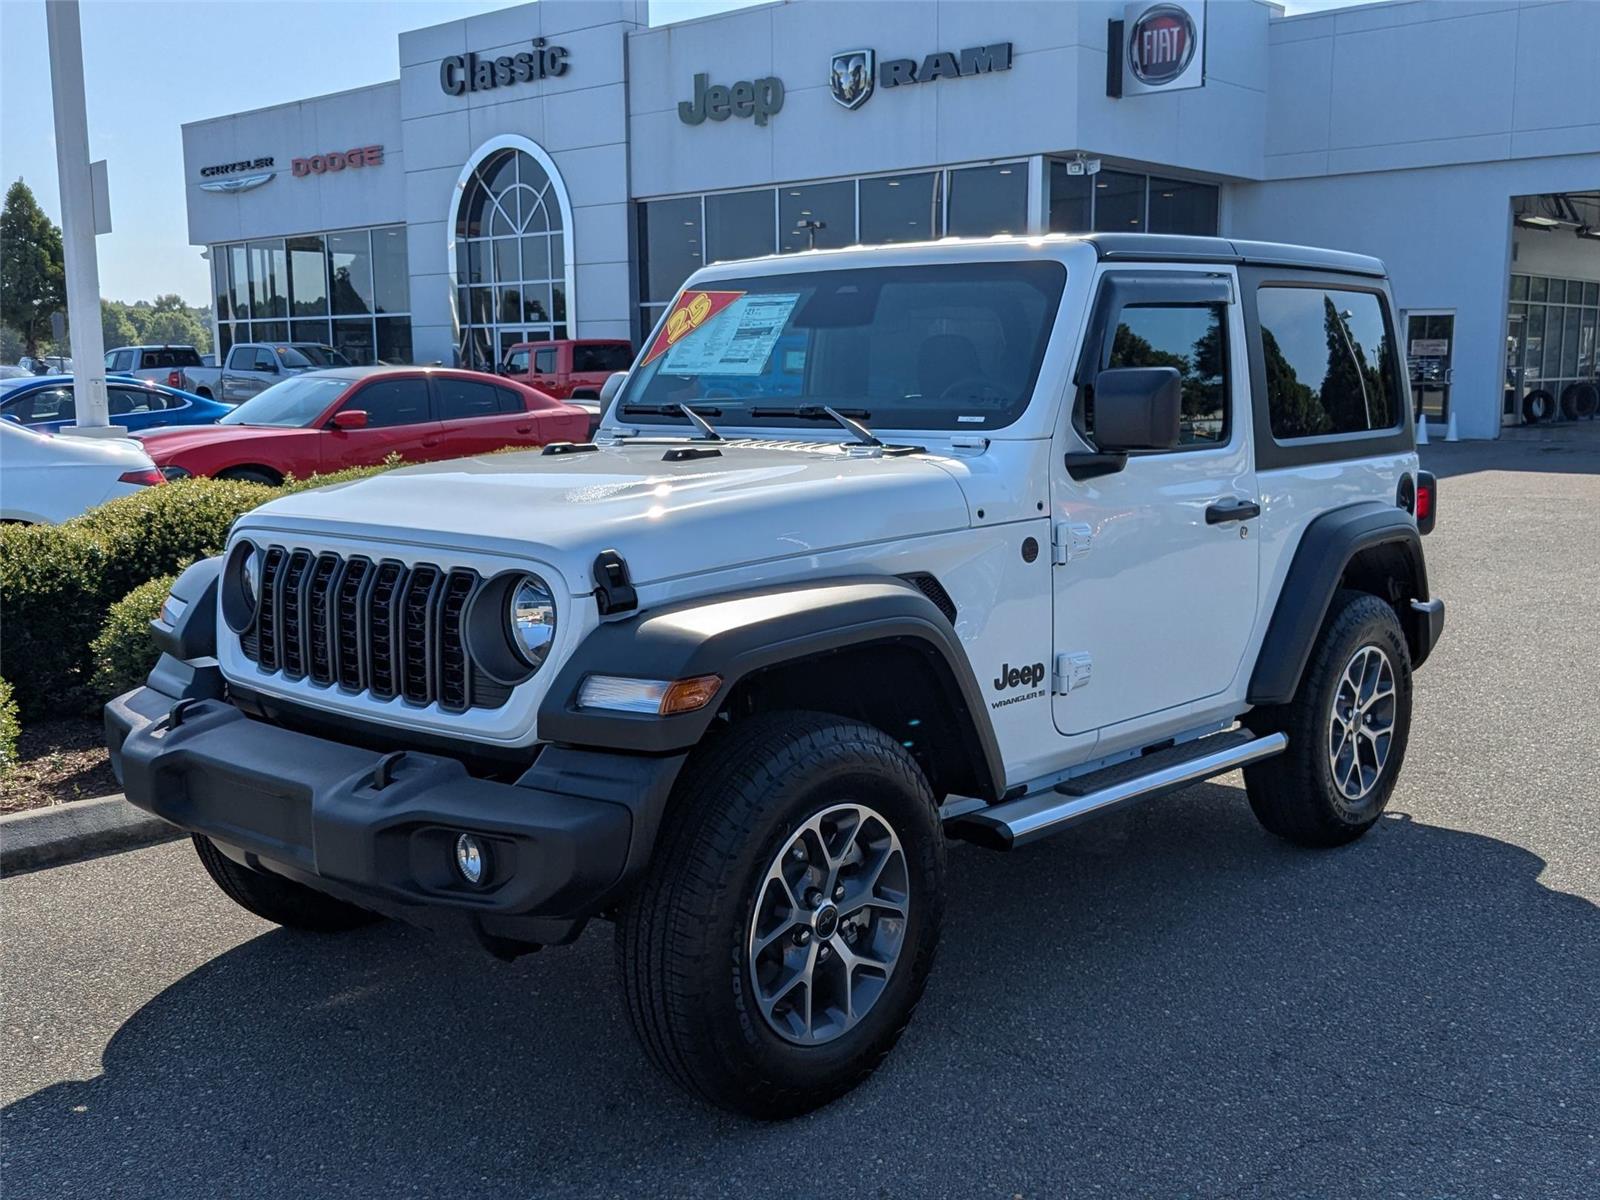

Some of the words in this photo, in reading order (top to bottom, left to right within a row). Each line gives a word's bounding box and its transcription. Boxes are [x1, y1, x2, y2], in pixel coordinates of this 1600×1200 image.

[880, 42, 1012, 89] RAM
[1142, 27, 1181, 66] FIAT
[440, 37, 569, 97] Classic
[678, 72, 785, 128] Jeep
[200, 156, 275, 178] CHRYSLER
[291, 144, 384, 177] DODGE
[667, 292, 712, 345] 25
[993, 662, 1046, 692] Jeep
[990, 692, 1038, 710] WRANGLER
